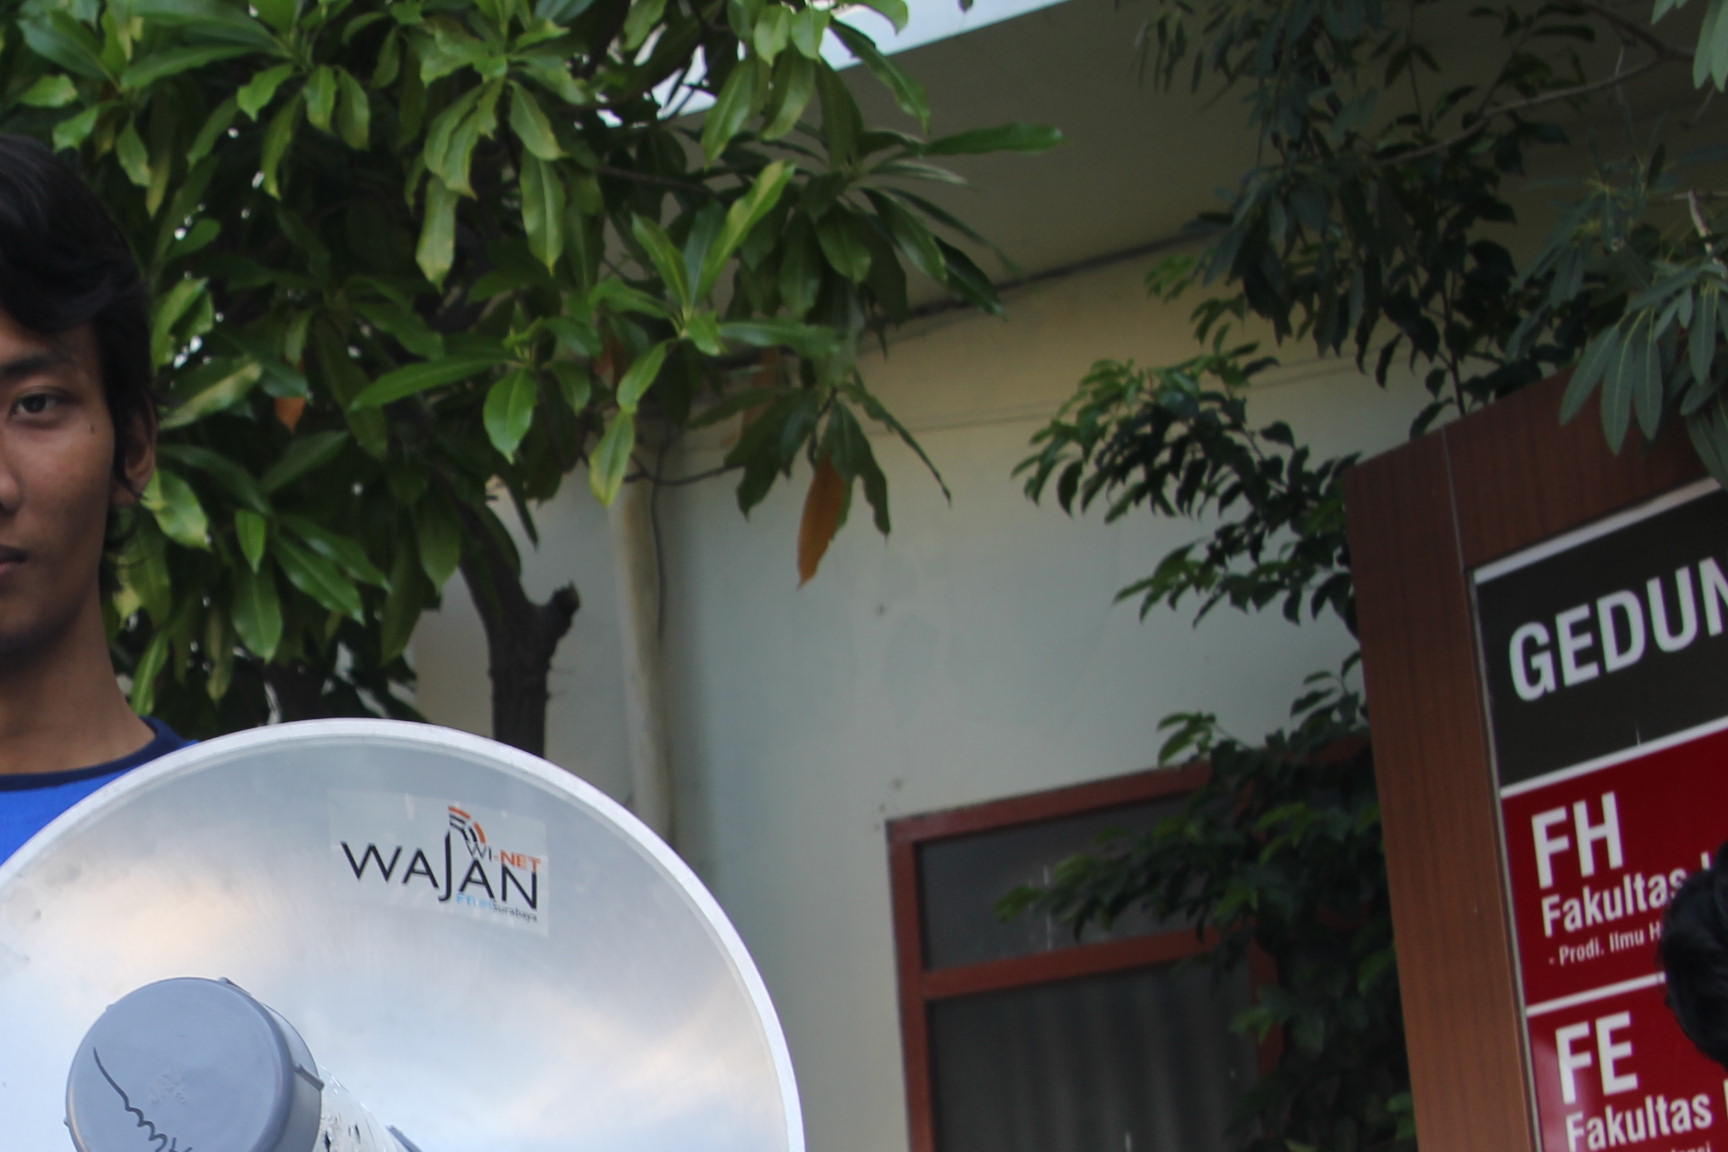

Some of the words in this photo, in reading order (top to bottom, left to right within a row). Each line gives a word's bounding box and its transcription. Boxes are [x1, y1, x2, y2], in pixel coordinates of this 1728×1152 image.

[340, 830, 538, 910] WAJAN
[1531, 791, 1624, 890] FH
[1558, 937, 1604, 966] Prodi.
[1609, 929, 1644, 953] Ilmu
[1555, 1010, 1638, 1105] FE
